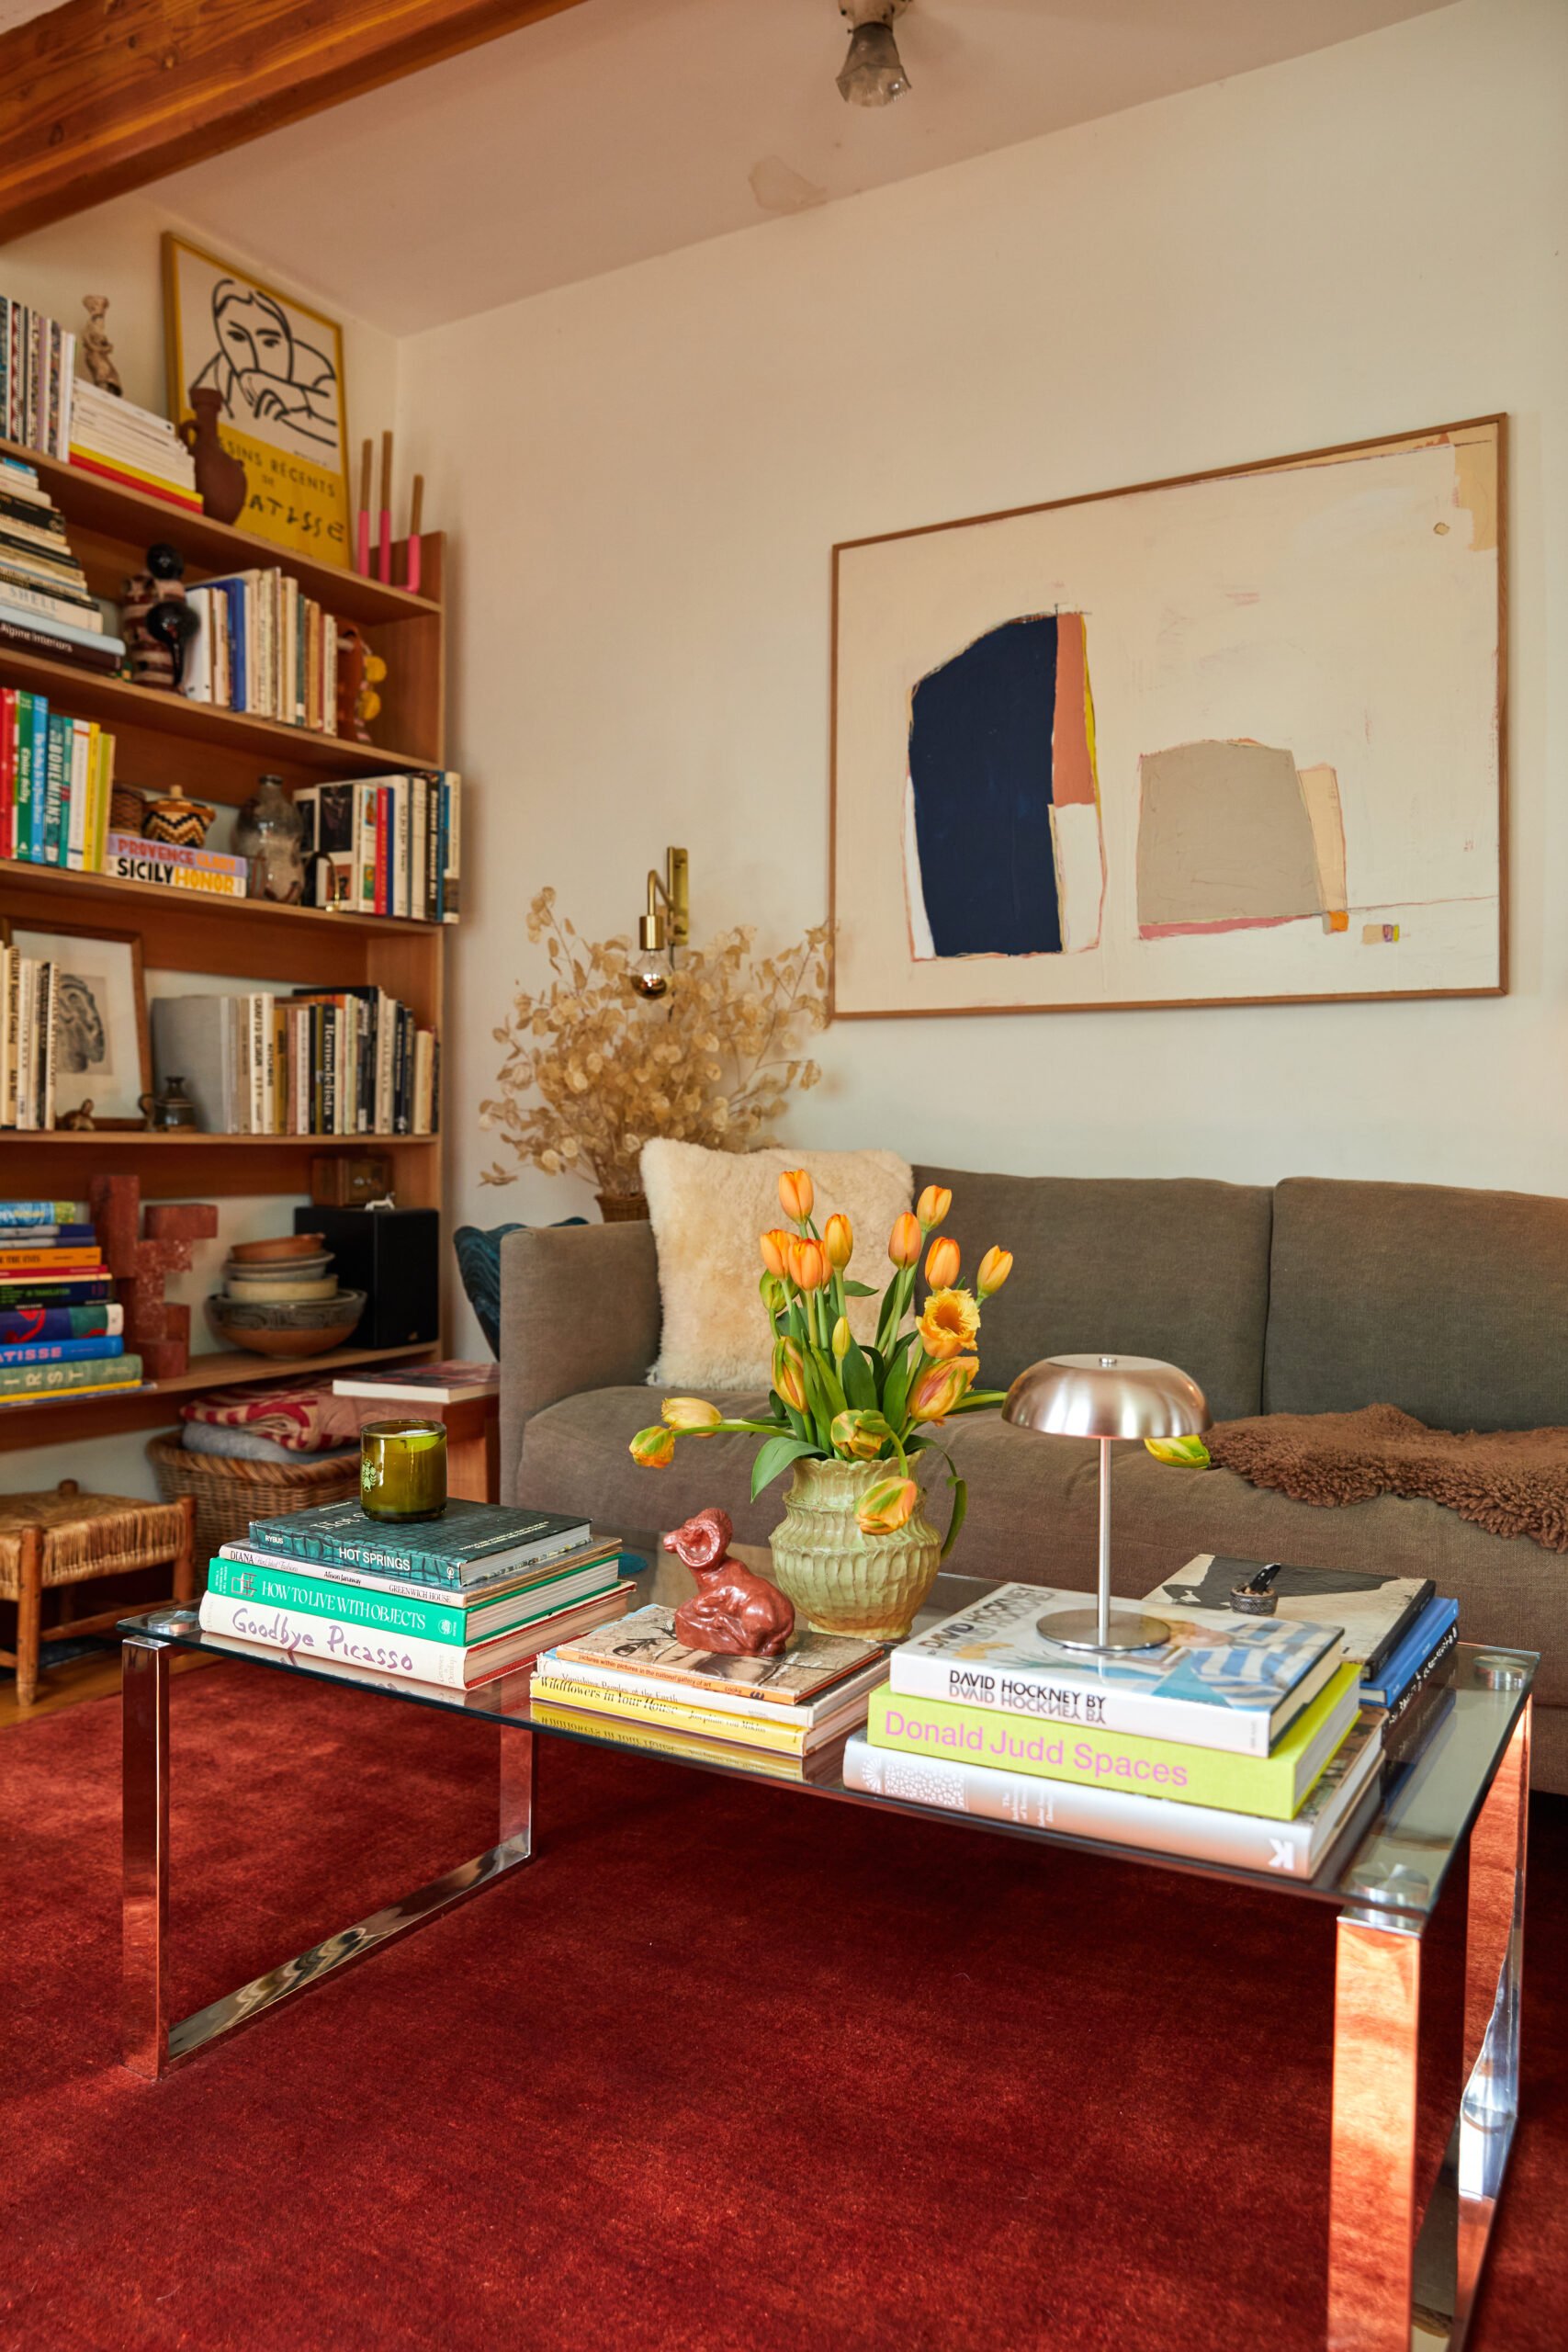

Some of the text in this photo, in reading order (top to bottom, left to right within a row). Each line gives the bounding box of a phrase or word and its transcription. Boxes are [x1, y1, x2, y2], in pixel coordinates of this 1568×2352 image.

[220, 436, 263, 467] SINS
[10, 586, 57, 612] SHELL
[1, 622, 31, 642] Alpine
[46, 743, 63, 825] BOHEMIANS
[118, 838, 195, 865] PROVENCE
[117, 858, 235, 894] SICILY HONOR
[323, 1023, 335, 1115] Remodelista
[265, 1534, 284, 1544] RYBUS
[231, 1550, 254, 1564] DIANA
[339, 1547, 411, 1571] HOT SPRINGS
[323, 1571, 361, 1586] Alison Janaway
[389, 1584, 451, 1603] GREENWICH HOUSE
[262, 1580, 426, 1630] HOW TO LIVE WITH OBJECTS
[232, 1608, 413, 1671] Goodbye Picasso
[578, 1655, 599, 1665] pictures
[601, 1658, 616, 1668] within
[616, 1662, 639, 1673] pictures
[646, 1668, 655, 1676] the
[655, 1670, 677, 1681] national
[677, 1674, 695, 1687] gallery
[725, 1686, 742, 1694] cooke
[950, 1669, 1107, 1710] DAVID HOCKNEY BY
[540, 1676, 601, 1699] Wildflowers
[604, 1690, 615, 1702] in
[617, 1692, 642, 1708] Your
[643, 1698, 678, 1714] House
[640, 1690, 653, 1698] the
[655, 1692, 678, 1702] Earth
[885, 1711, 1189, 1786] Donald Judd Spaces
